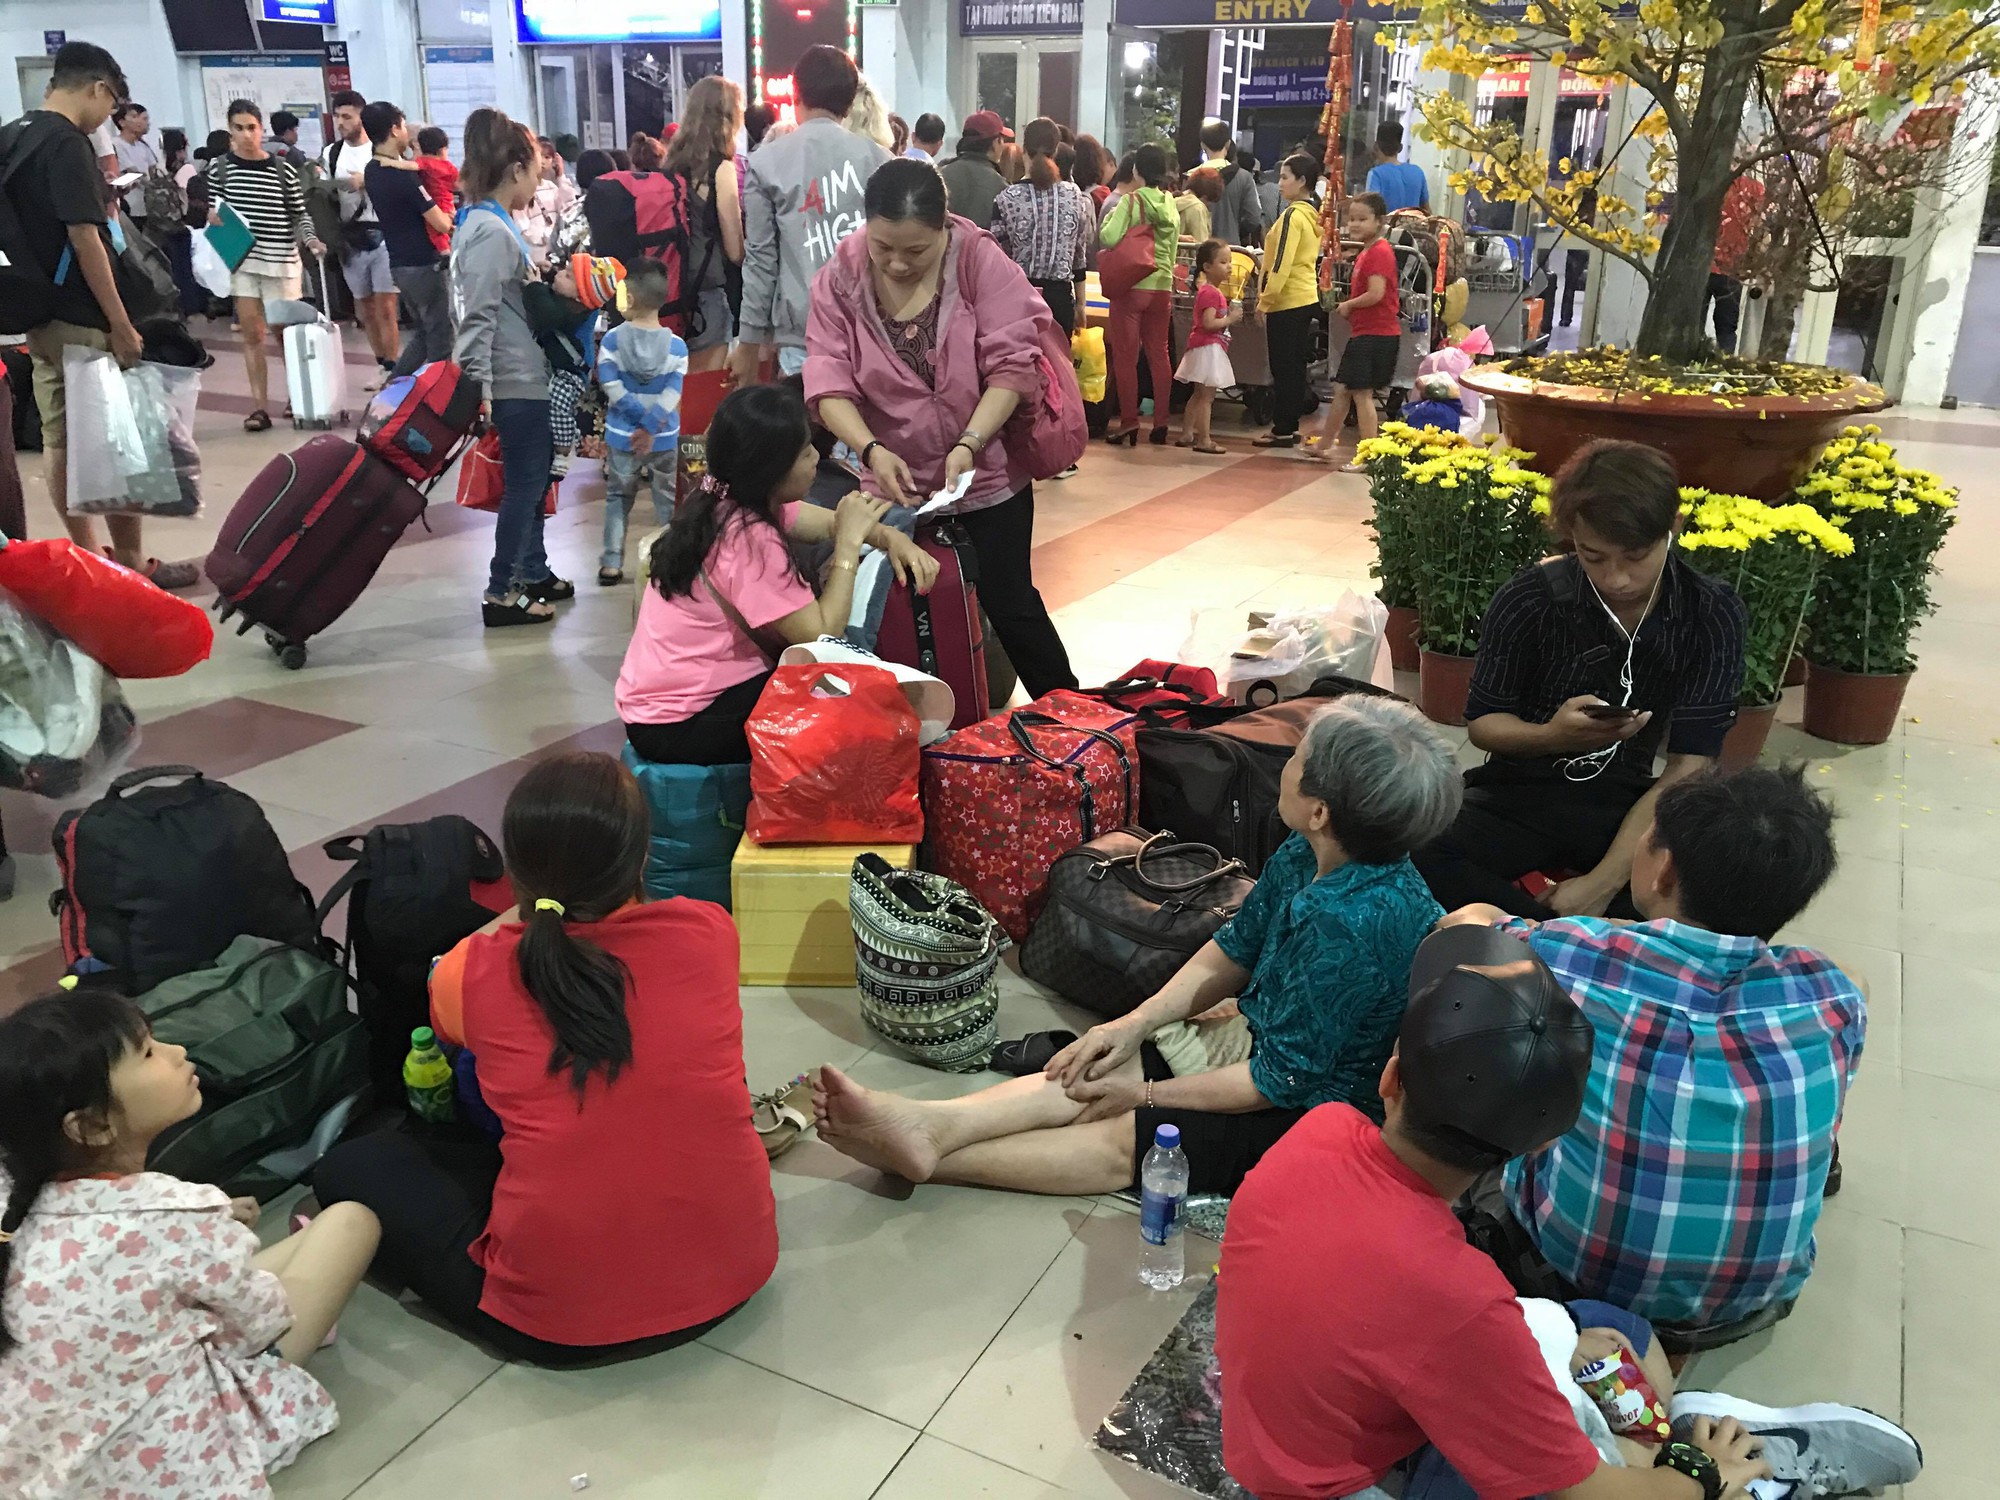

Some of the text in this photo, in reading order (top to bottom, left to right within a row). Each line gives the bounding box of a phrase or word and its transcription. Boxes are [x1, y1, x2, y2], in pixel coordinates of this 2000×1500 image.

[1215, 0, 1311, 20] ENTRY
[329, 45, 344, 56] WC
[798, 160, 866, 216] AIM
